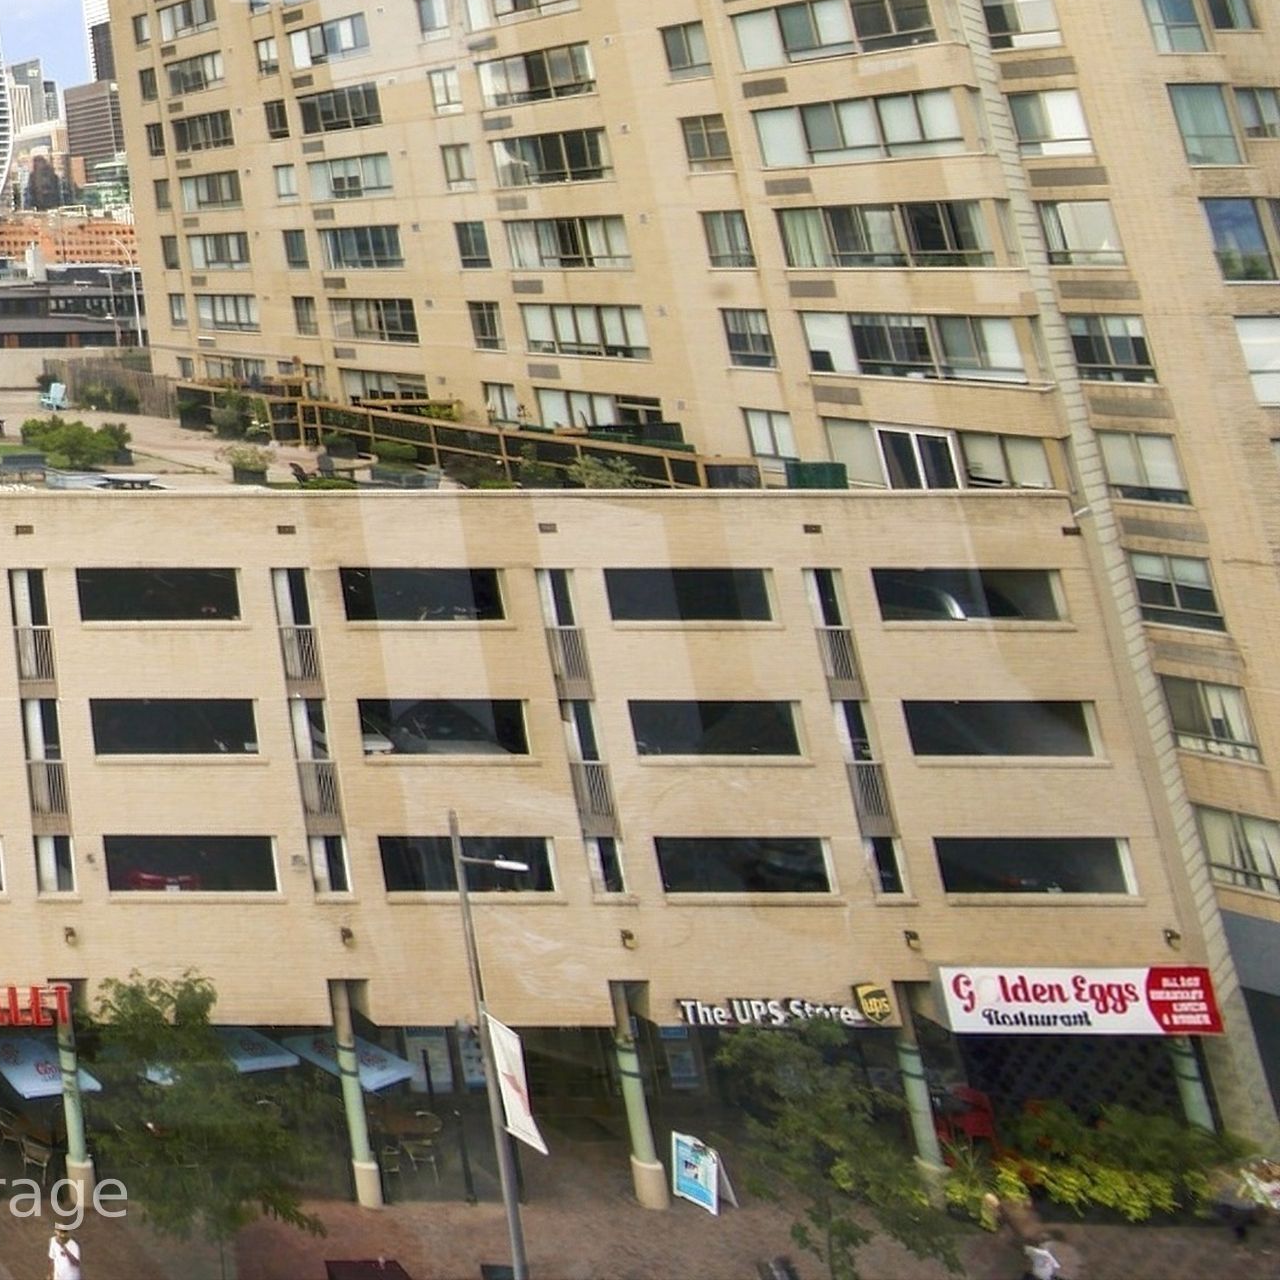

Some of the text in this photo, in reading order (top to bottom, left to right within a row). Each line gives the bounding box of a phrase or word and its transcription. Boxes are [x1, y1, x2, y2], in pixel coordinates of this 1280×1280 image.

[1071, 975, 1141, 1014] Eggs
[679, 999, 856, 1026] The UPS Store
[864, 997, 891, 1017] ups
[982, 1008, 1092, 1026] Restaurant
